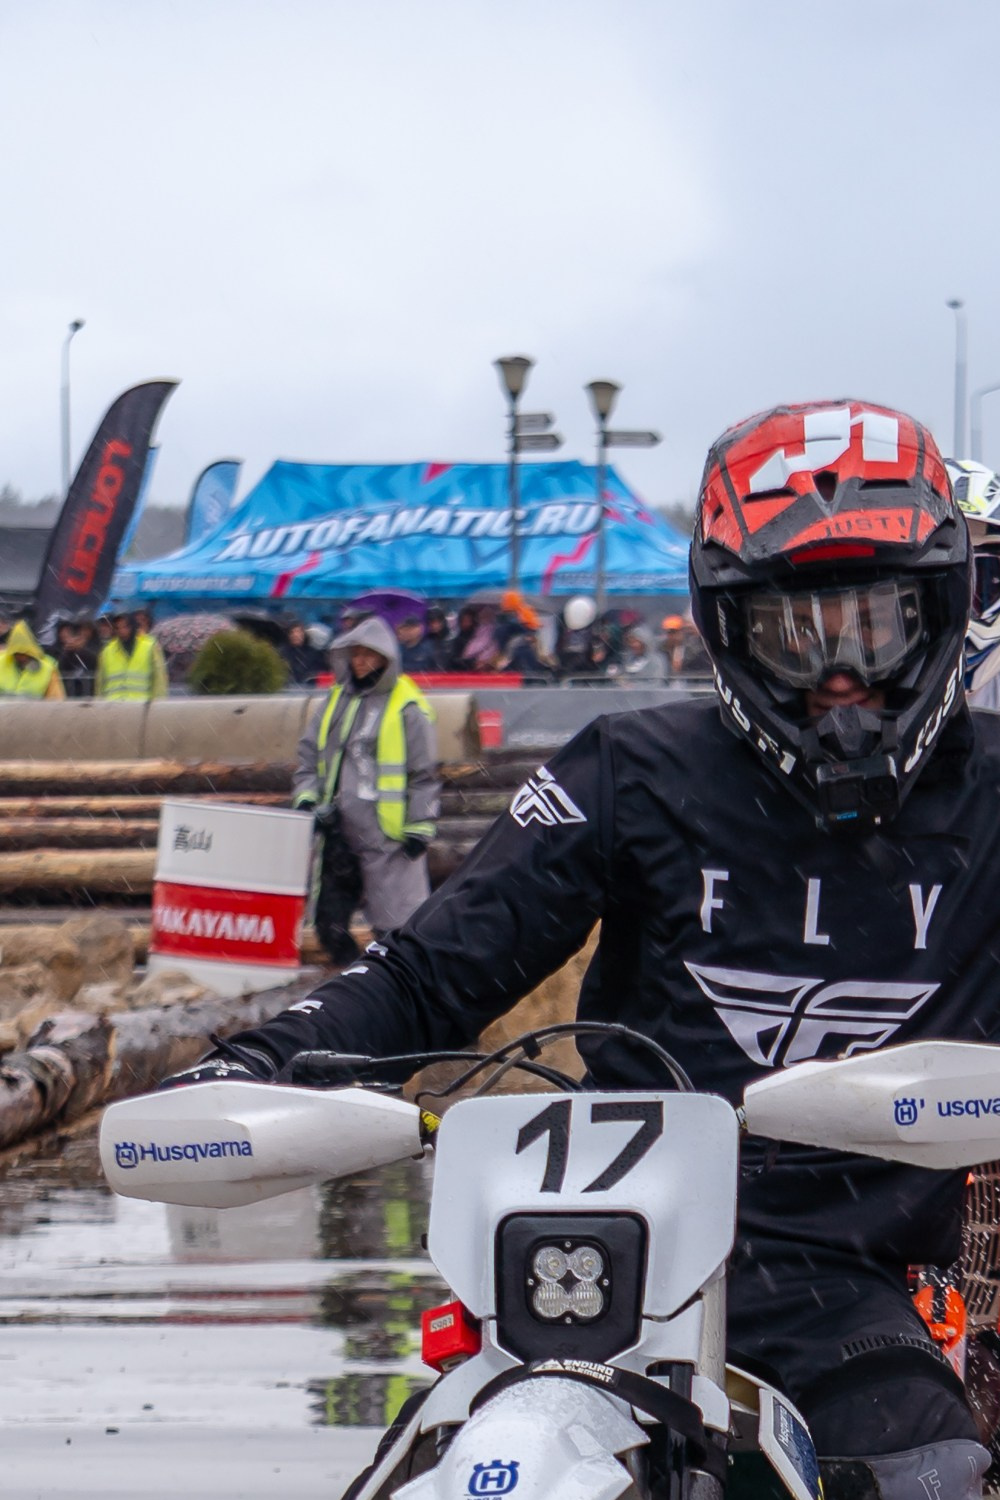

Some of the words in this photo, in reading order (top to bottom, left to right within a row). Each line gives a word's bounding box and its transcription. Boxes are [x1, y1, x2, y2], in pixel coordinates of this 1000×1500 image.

[700, 868, 943, 950] FLY
[139, 1140, 253, 1162] Husqvarna
[515, 1098, 664, 1194] 17
[563, 1359, 615, 1377] ENDURO
[565, 1365, 613, 1383] ELEMENT
